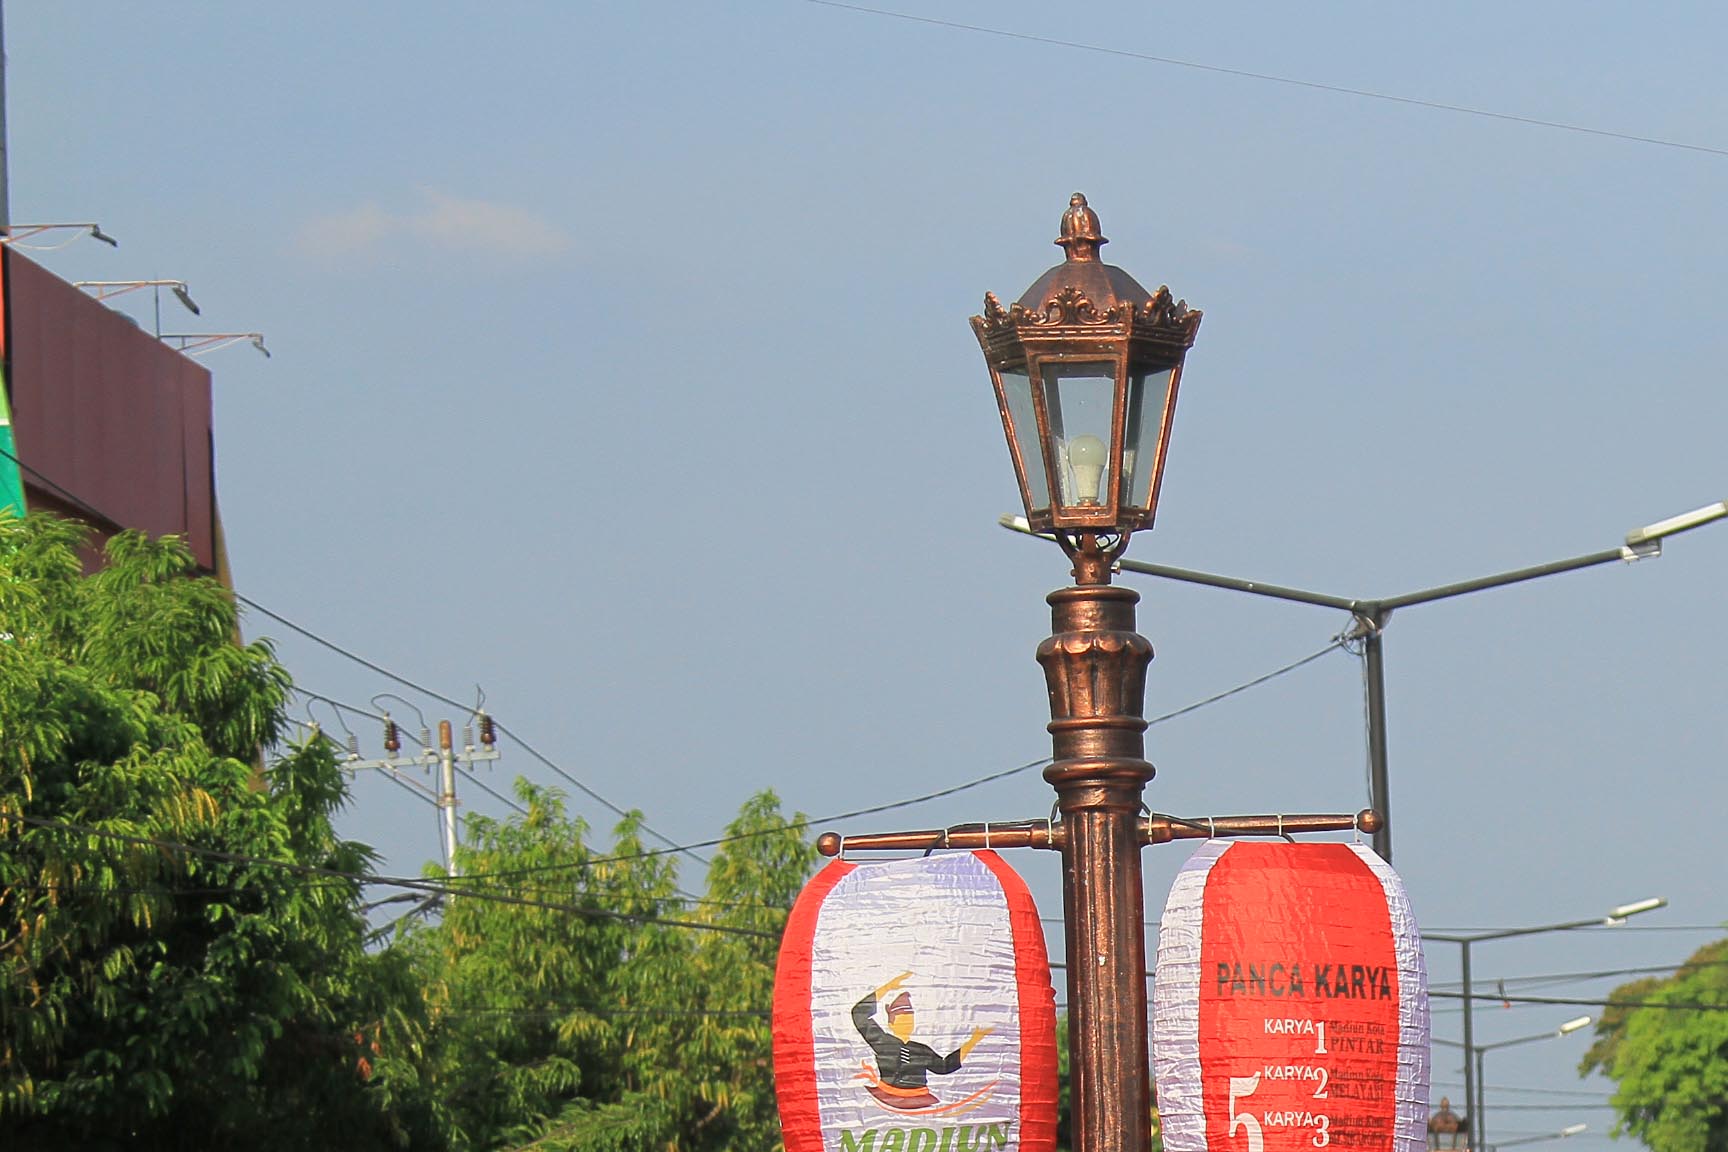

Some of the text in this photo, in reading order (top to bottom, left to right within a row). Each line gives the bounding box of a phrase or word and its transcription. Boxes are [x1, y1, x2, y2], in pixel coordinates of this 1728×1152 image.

[1217, 962, 1392, 1000] PANCA KARYA
[1264, 1018, 1328, 1054] KARYA 1
[1331, 1037, 1385, 1054] PINTAR
[1264, 1065, 1329, 1099] KARYA 2
[1264, 1111, 1314, 1127] KARYA
[1312, 1115, 1330, 1147] 3
